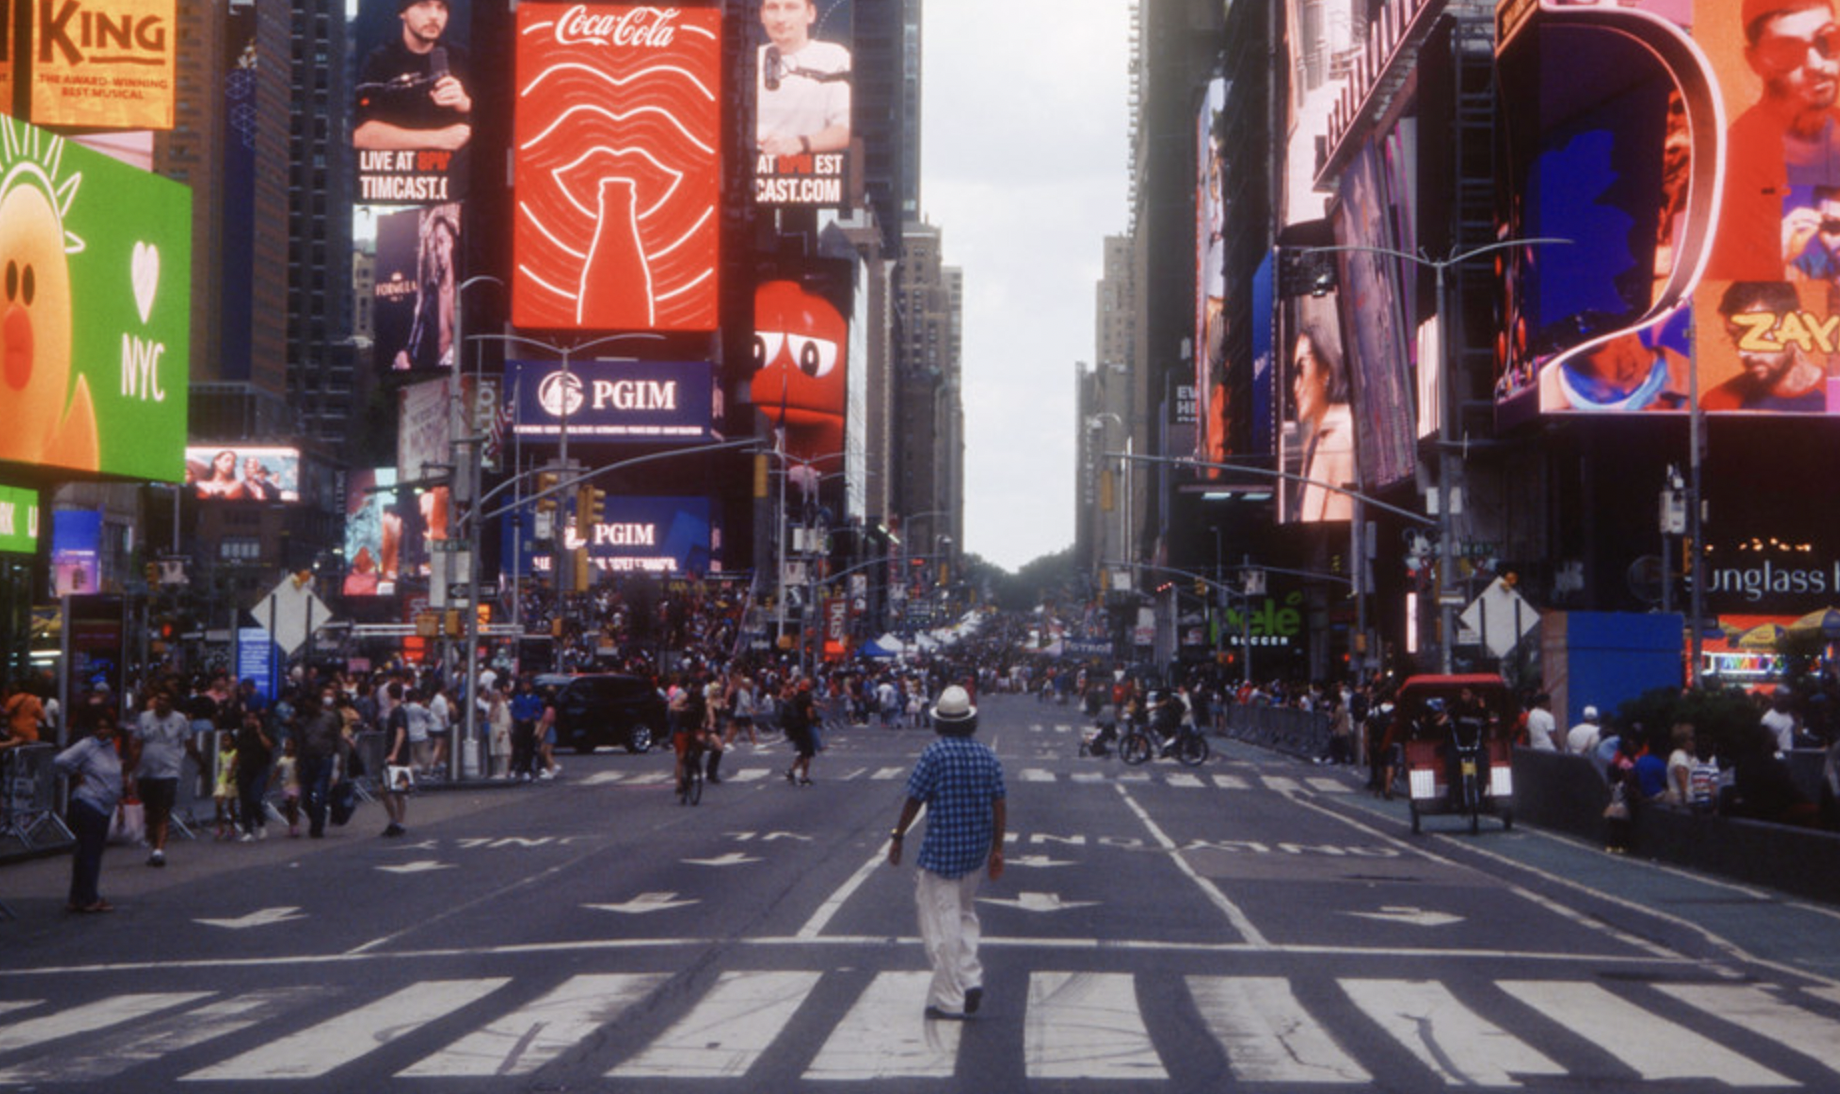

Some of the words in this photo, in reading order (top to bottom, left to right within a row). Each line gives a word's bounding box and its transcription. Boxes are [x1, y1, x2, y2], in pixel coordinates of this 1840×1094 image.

[38, 0, 166, 66] KING
[555, 4, 682, 46] Coca-Cola
[39, 74, 61, 84] THE
[61, 86, 88, 97] BEST
[91, 87, 144, 100] MUSICAL
[360, 151, 393, 171] LIVE
[396, 151, 415, 171] AT
[757, 154, 775, 174] AT
[815, 154, 843, 174] EST
[1730, 311, 1840, 354] ZAY
[121, 332, 165, 402] NYC
[592, 380, 677, 410] PGIM
[594, 523, 655, 546] PGIM
